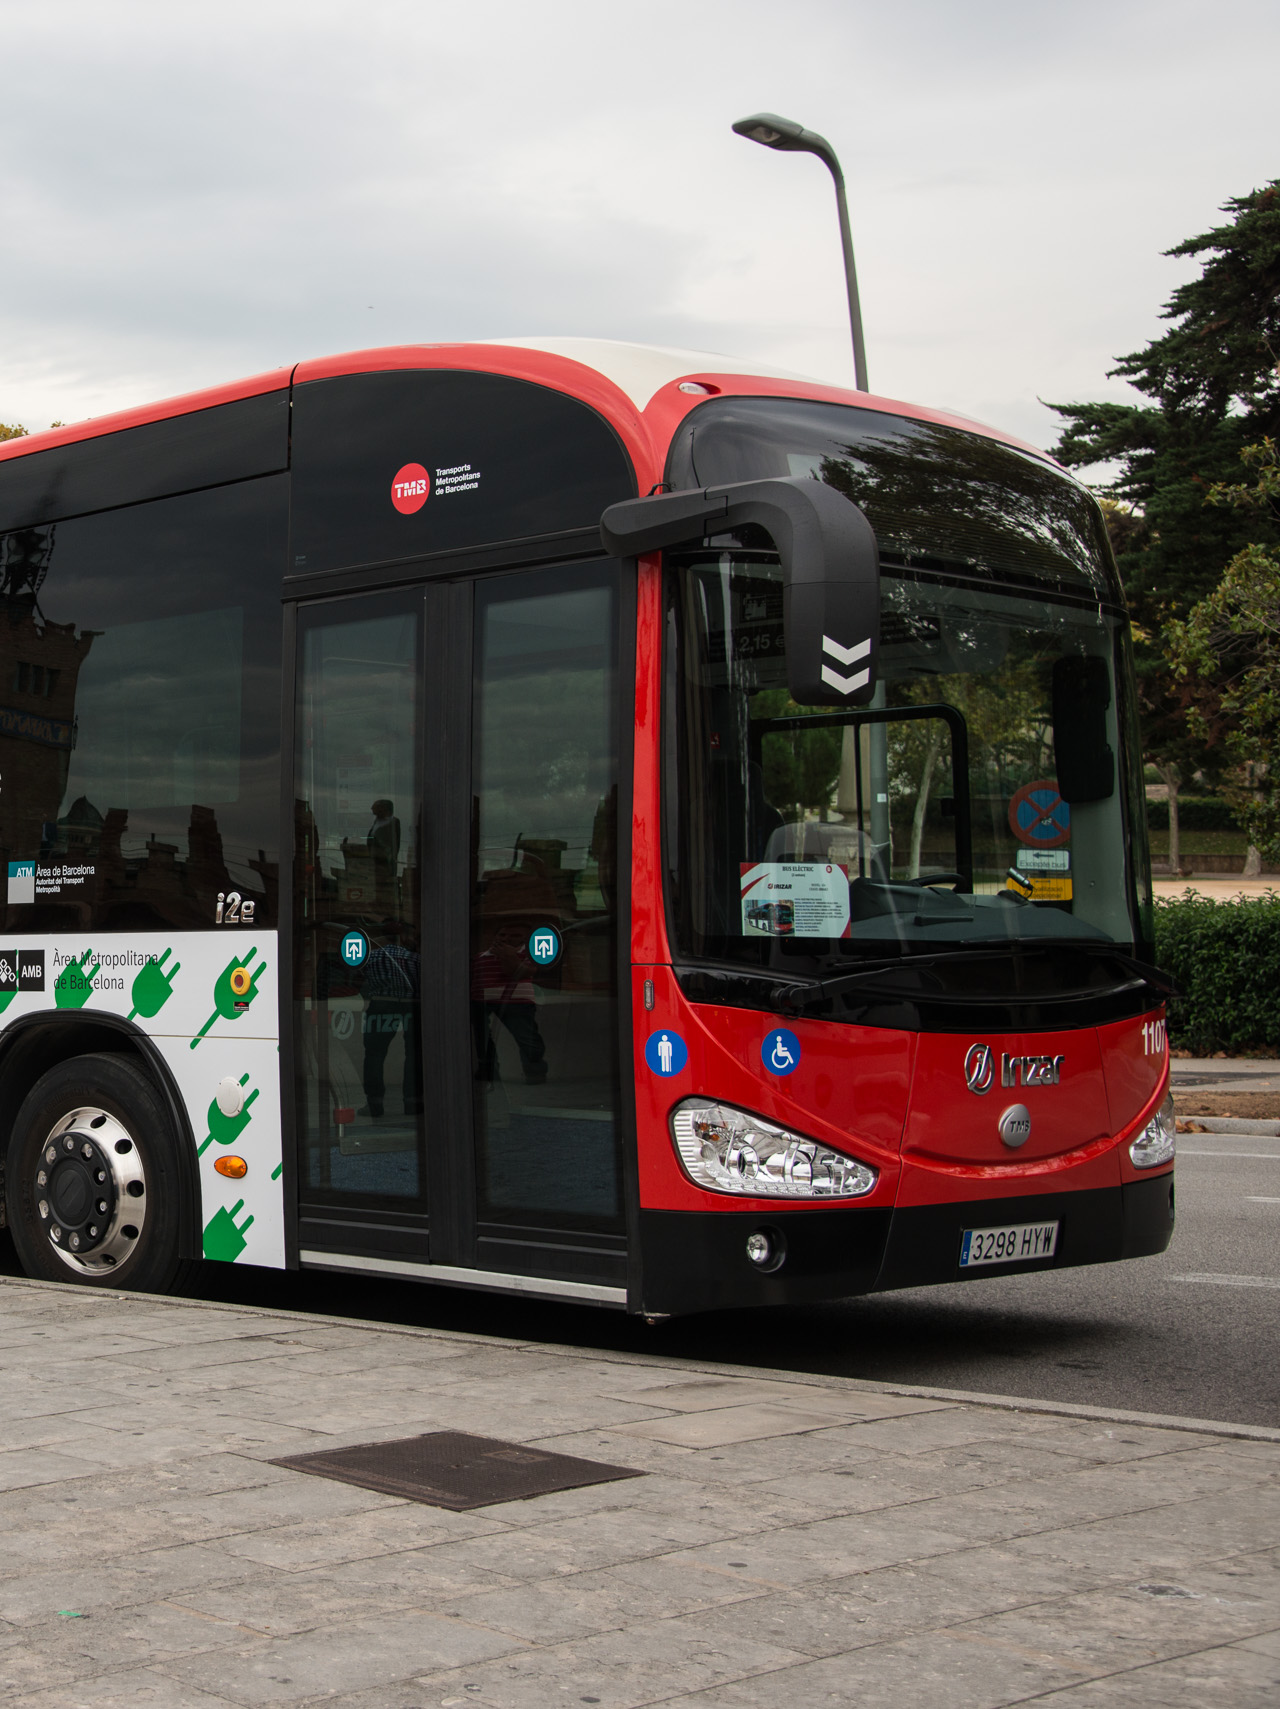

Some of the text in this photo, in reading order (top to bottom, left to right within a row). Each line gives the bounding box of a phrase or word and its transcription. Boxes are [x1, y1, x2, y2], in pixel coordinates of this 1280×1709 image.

[435, 463, 471, 477] Transports
[435, 472, 481, 486] Metropolitans
[394, 479, 427, 499] TMB
[435, 481, 478, 496] de Barcelona
[16, 866, 33, 878] ATM
[35, 864, 95, 877] Àrea de Barcelona
[35, 878, 55, 886] Autoritat
[63, 876, 84, 885] Transport
[215, 891, 256, 924] i2e
[53, 948, 159, 970] Àrea Metropolitana
[21, 964, 42, 978] AMB
[53, 974, 124, 990] de Barcelona
[1141, 1018, 1166, 1056] 1107
[1001, 1052, 1065, 1088] Irizar
[1009, 1120, 1030, 1133] TMB
[972, 1226, 1055, 1262] 3298 HYW
